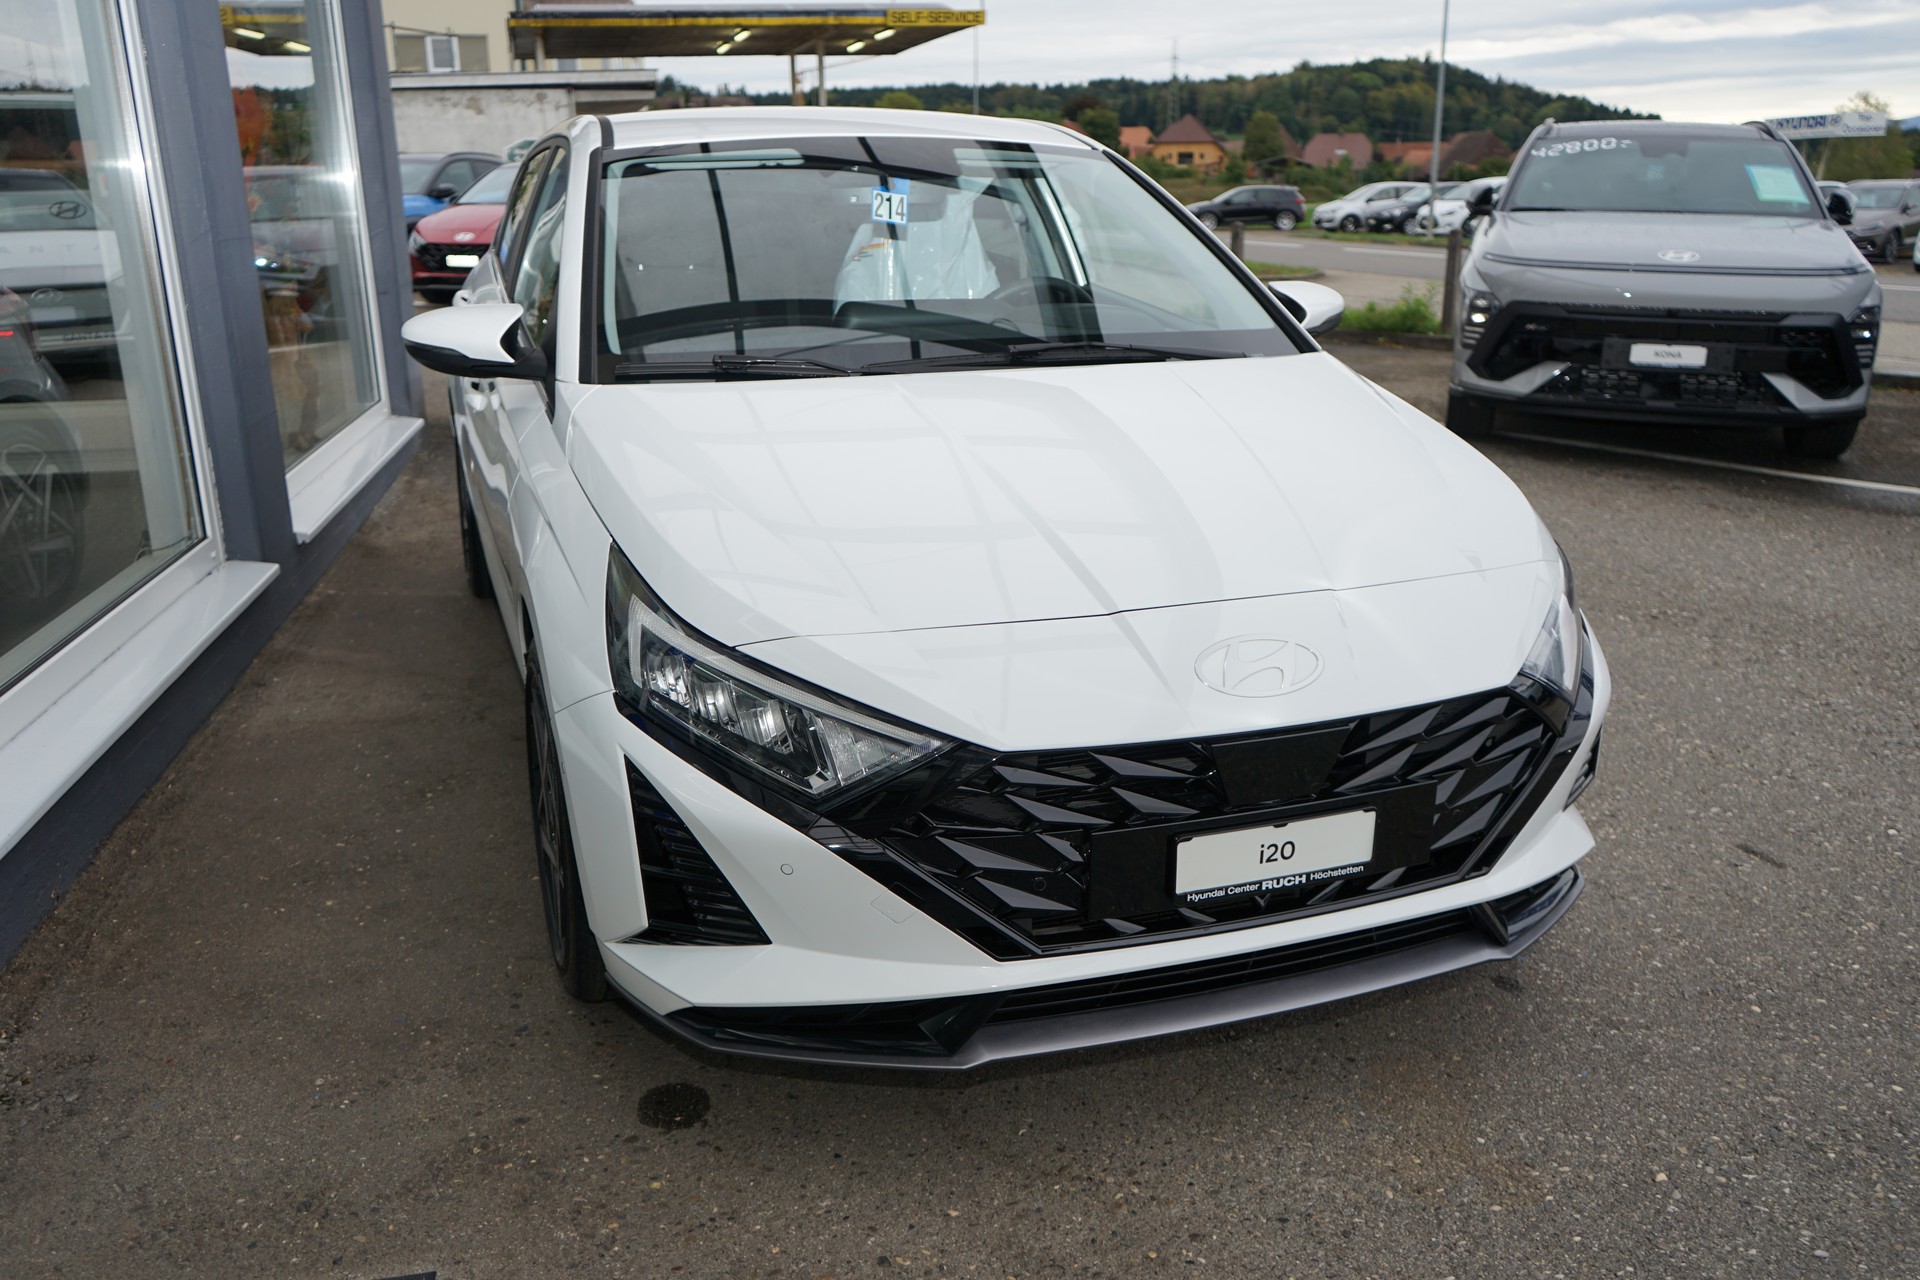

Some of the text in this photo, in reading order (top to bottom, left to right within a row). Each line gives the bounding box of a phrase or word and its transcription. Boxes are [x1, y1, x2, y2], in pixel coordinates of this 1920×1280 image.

[892, 11, 982, 23] SELF-SERVICE
[874, 192, 906, 221] 214
[1259, 841, 1296, 864] i20
[1187, 864, 1364, 902] Hyundai Center RUCH Höchstetten
